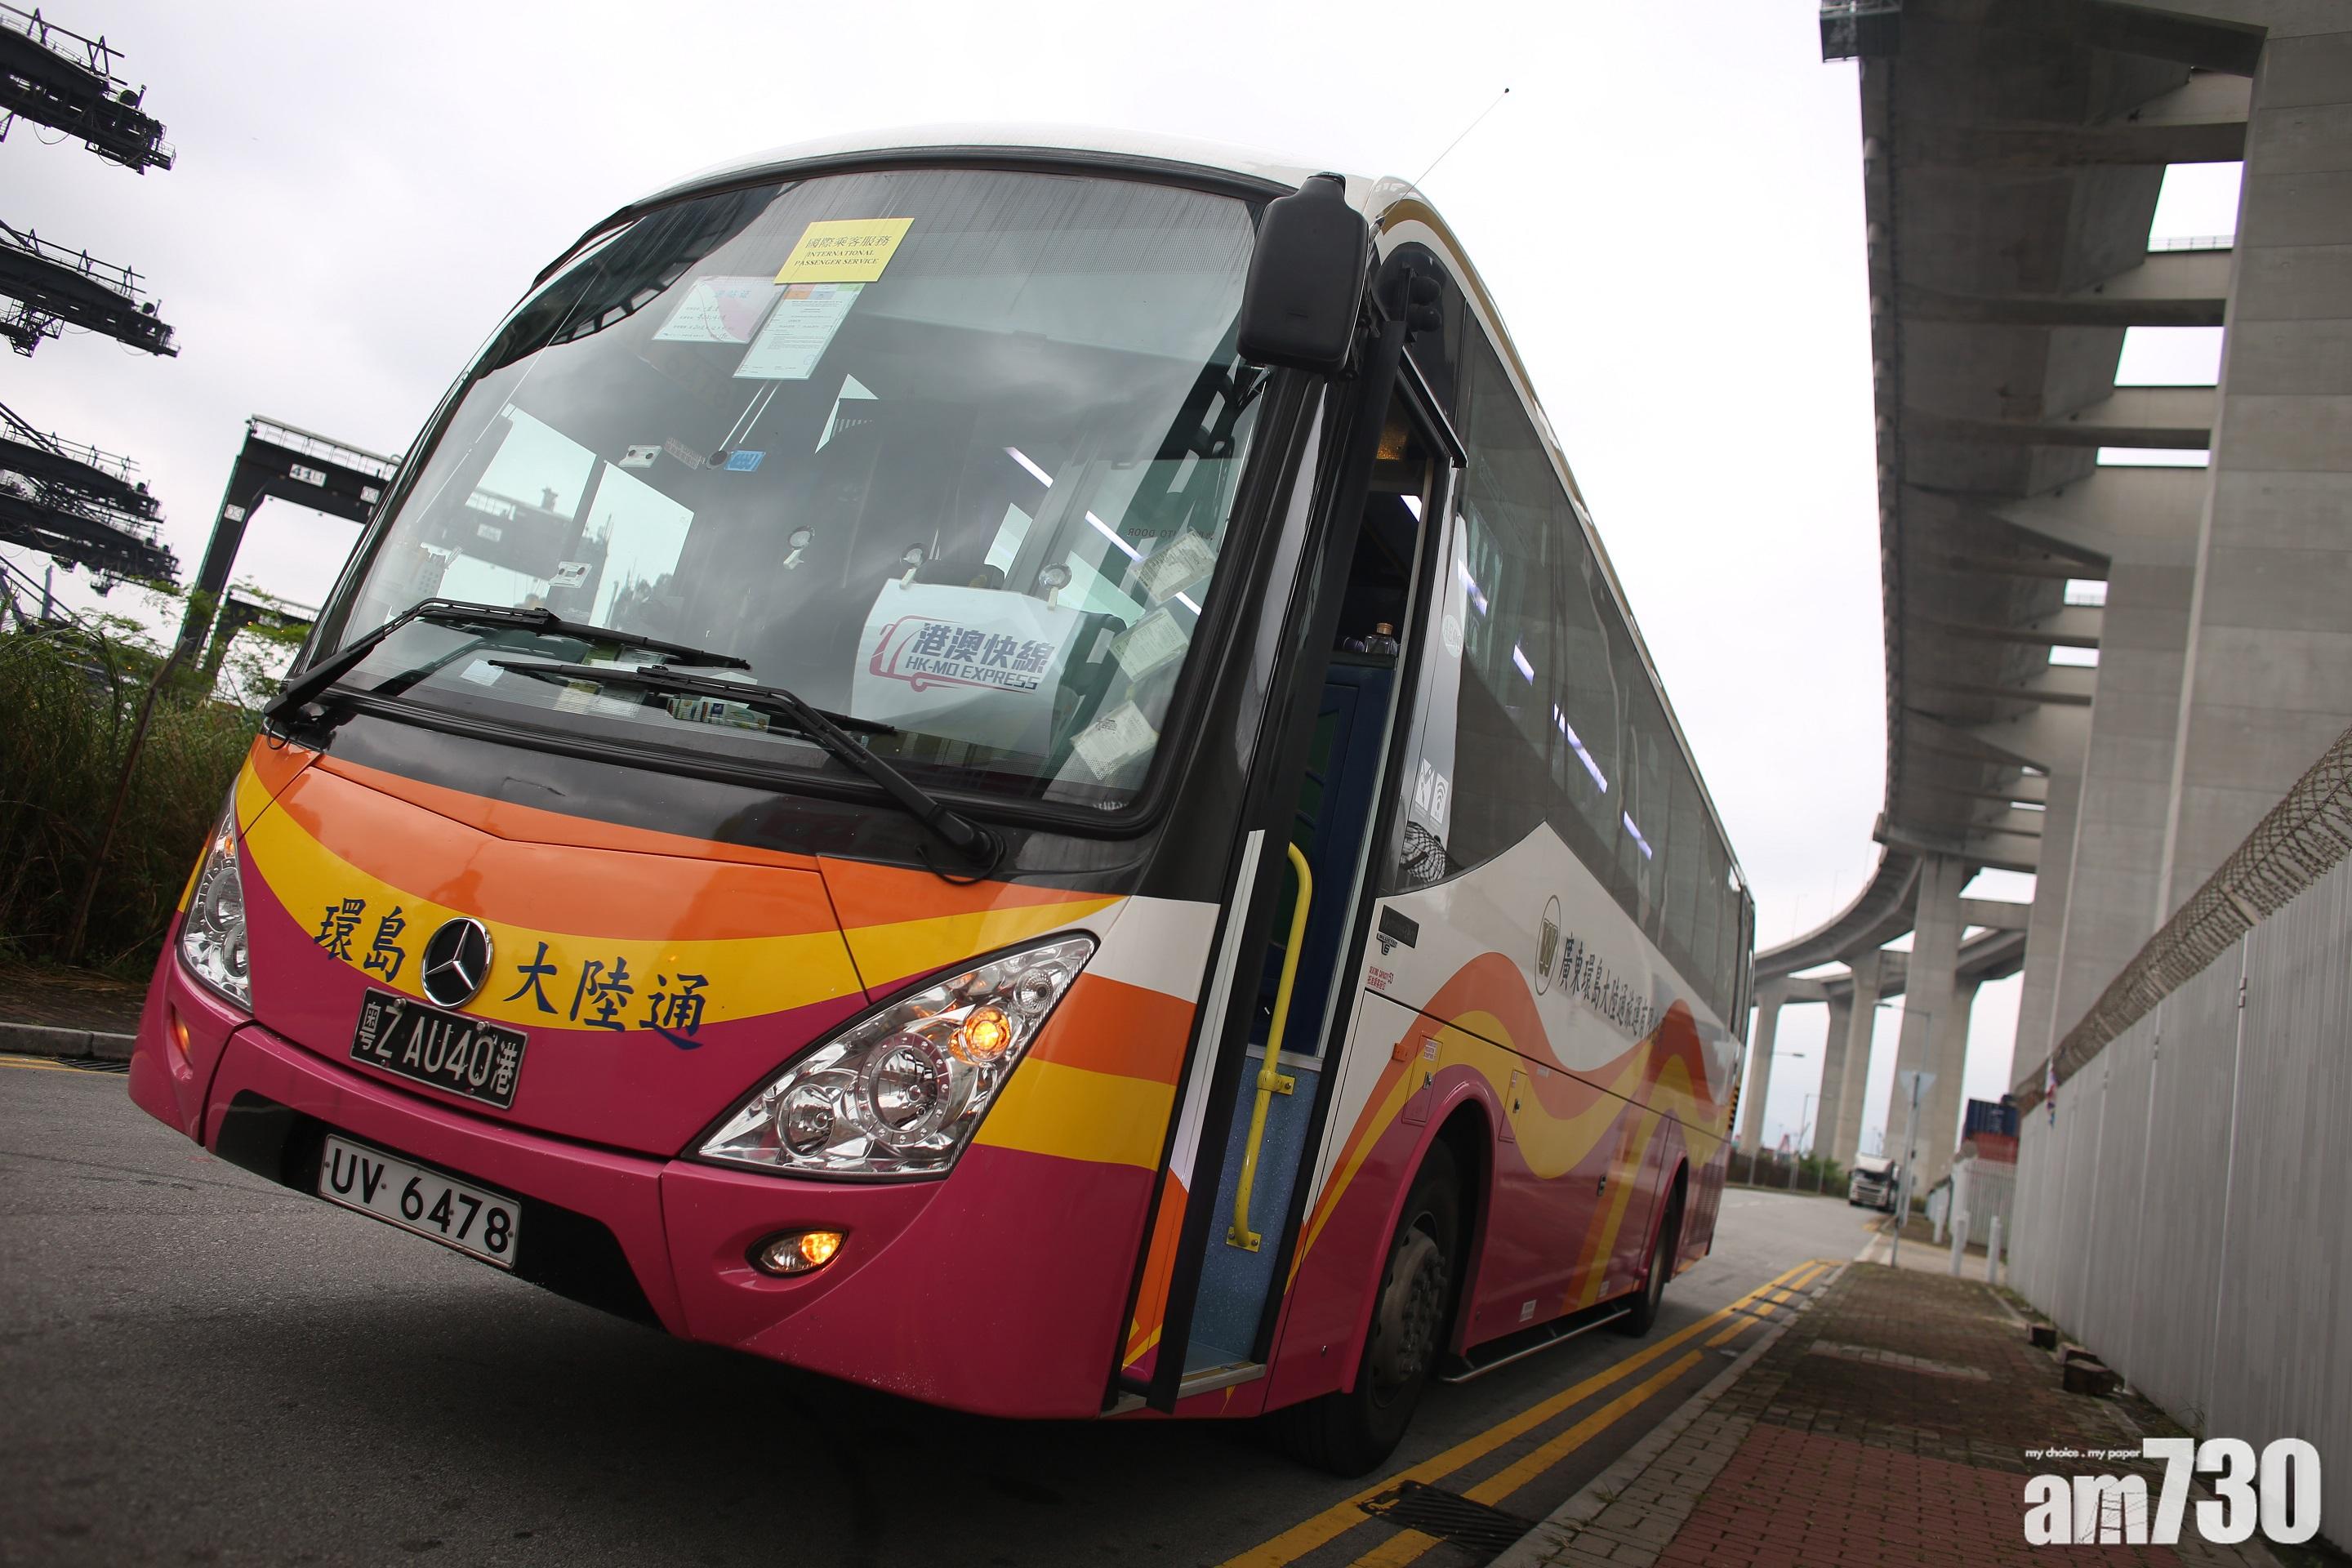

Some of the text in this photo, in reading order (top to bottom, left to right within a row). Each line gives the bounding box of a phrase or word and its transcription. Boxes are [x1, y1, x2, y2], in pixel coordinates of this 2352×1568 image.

[905, 656, 1040, 690] HK-MO EXPRESS
[911, 621, 1055, 674] 港澳快線
[314, 898, 710, 1050] 環島 大陸通
[331, 1148, 511, 1254] UV 6478
